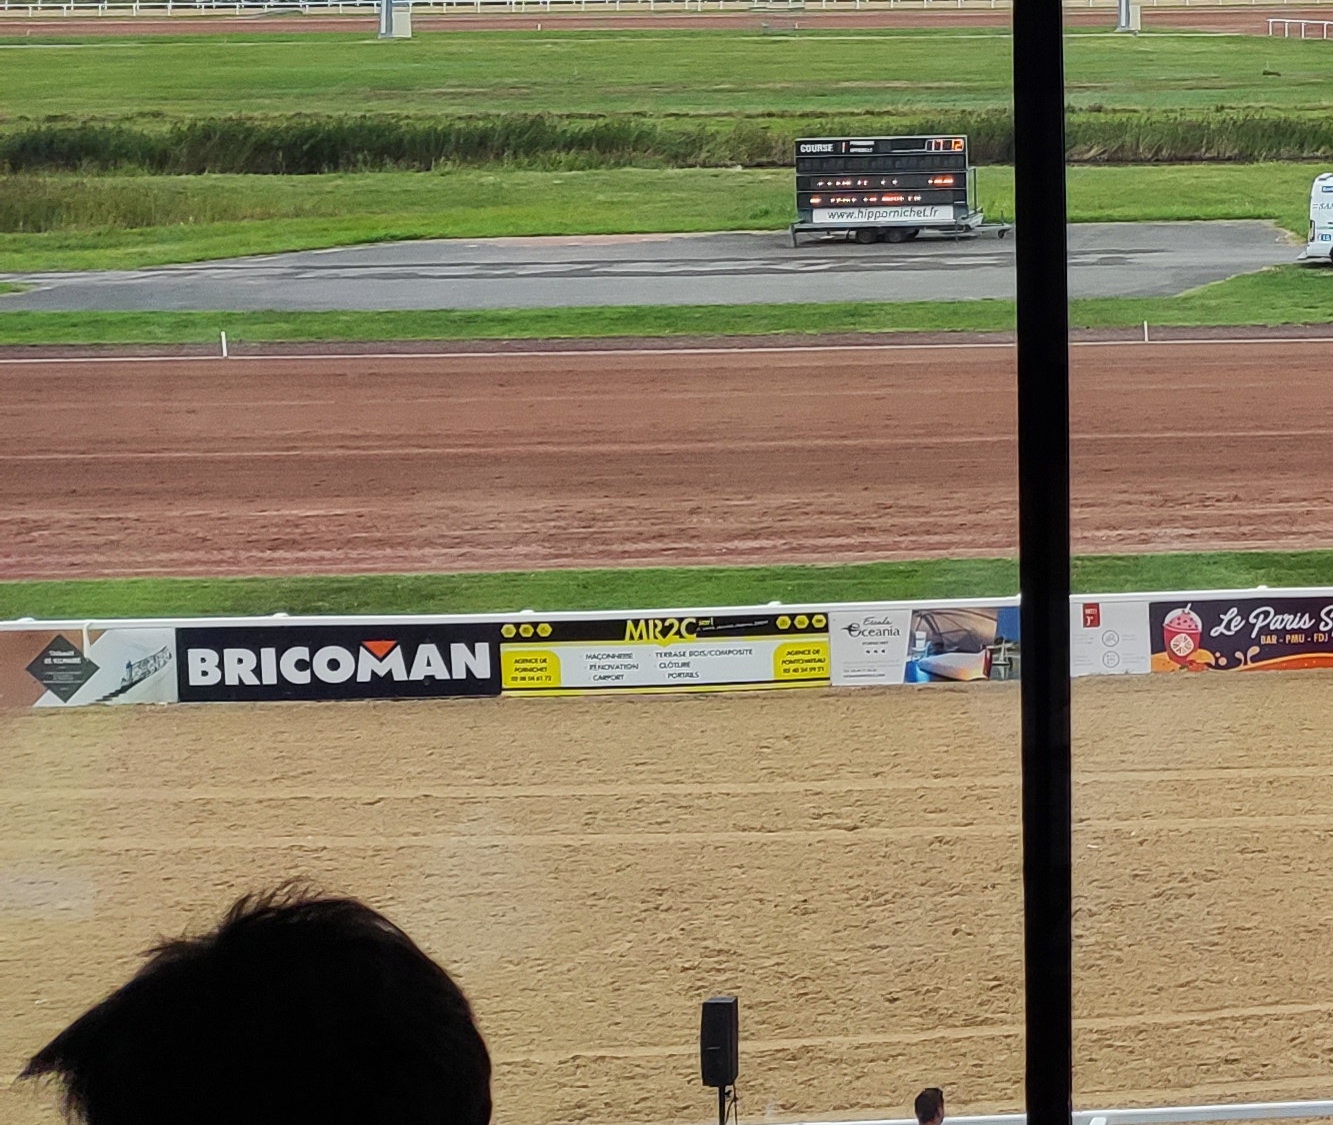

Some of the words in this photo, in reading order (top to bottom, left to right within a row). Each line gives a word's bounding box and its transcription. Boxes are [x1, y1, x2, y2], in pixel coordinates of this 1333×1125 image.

[800, 143, 834, 153] COURSE
[1210, 607, 1245, 637] Le
[1249, 606, 1315, 639] Paris
[625, 617, 697, 642] MR2C
[843, 623, 900, 638] Oceania
[1261, 635, 1278, 644] BAR
[1285, 633, 1305, 643] PMU
[1313, 632, 1329, 642] FDJ
[688, 648, 753, 657] BOIS/COMPOSITE
[187, 641, 491, 686] BRICOMAN
[589, 662, 639, 671] RÉNOVATION
[659, 660, 691, 669] CLÔTURE
[667, 671, 700, 679] PORTAILS
